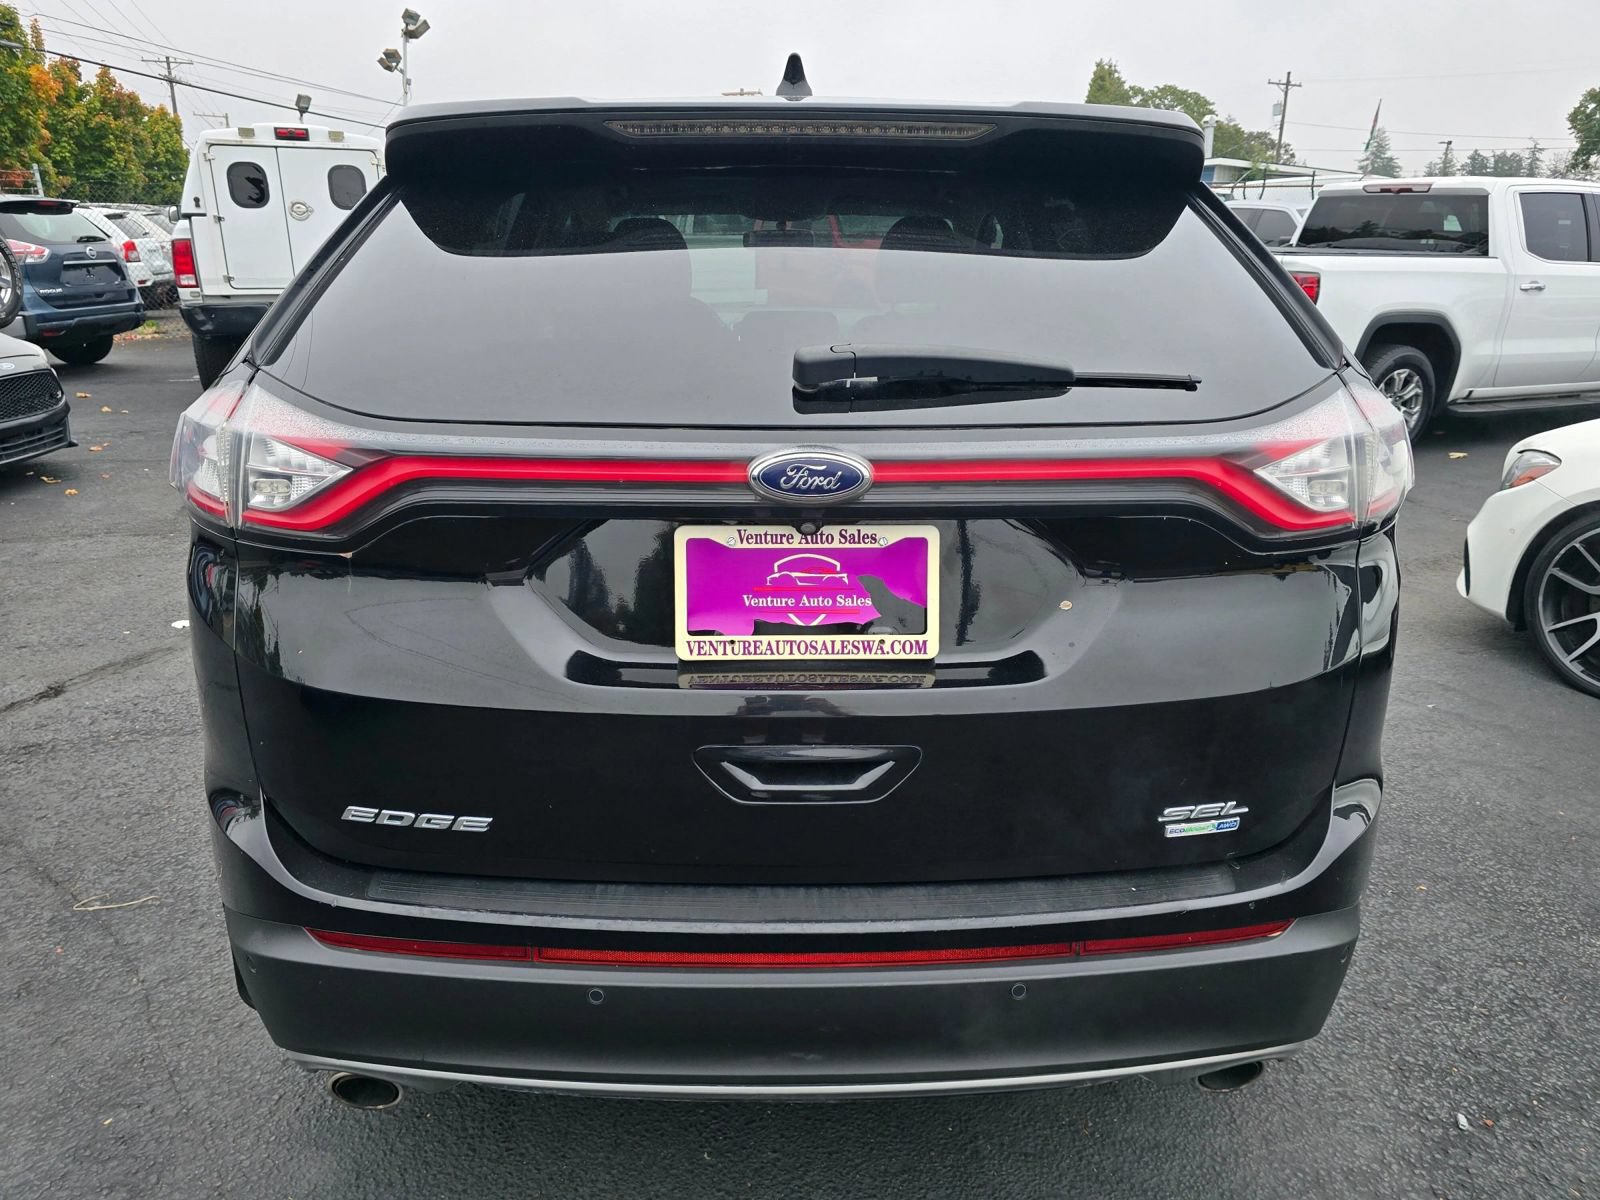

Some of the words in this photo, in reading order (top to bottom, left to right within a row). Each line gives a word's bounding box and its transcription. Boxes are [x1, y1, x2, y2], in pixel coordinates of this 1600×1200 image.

[780, 463, 842, 490] Ford
[736, 529, 794, 545] Venture
[799, 531, 835, 545] Auto
[838, 528, 877, 545] Sales
[742, 594, 796, 607] Venture
[799, 594, 832, 607] Auto
[835, 594, 873, 607] Sales
[686, 639, 928, 656] VENTUREAUTOSALESWA.COM
[341, 805, 493, 832] EDGE
[1157, 801, 1249, 822] SEL
[1218, 820, 1237, 830] AWD
